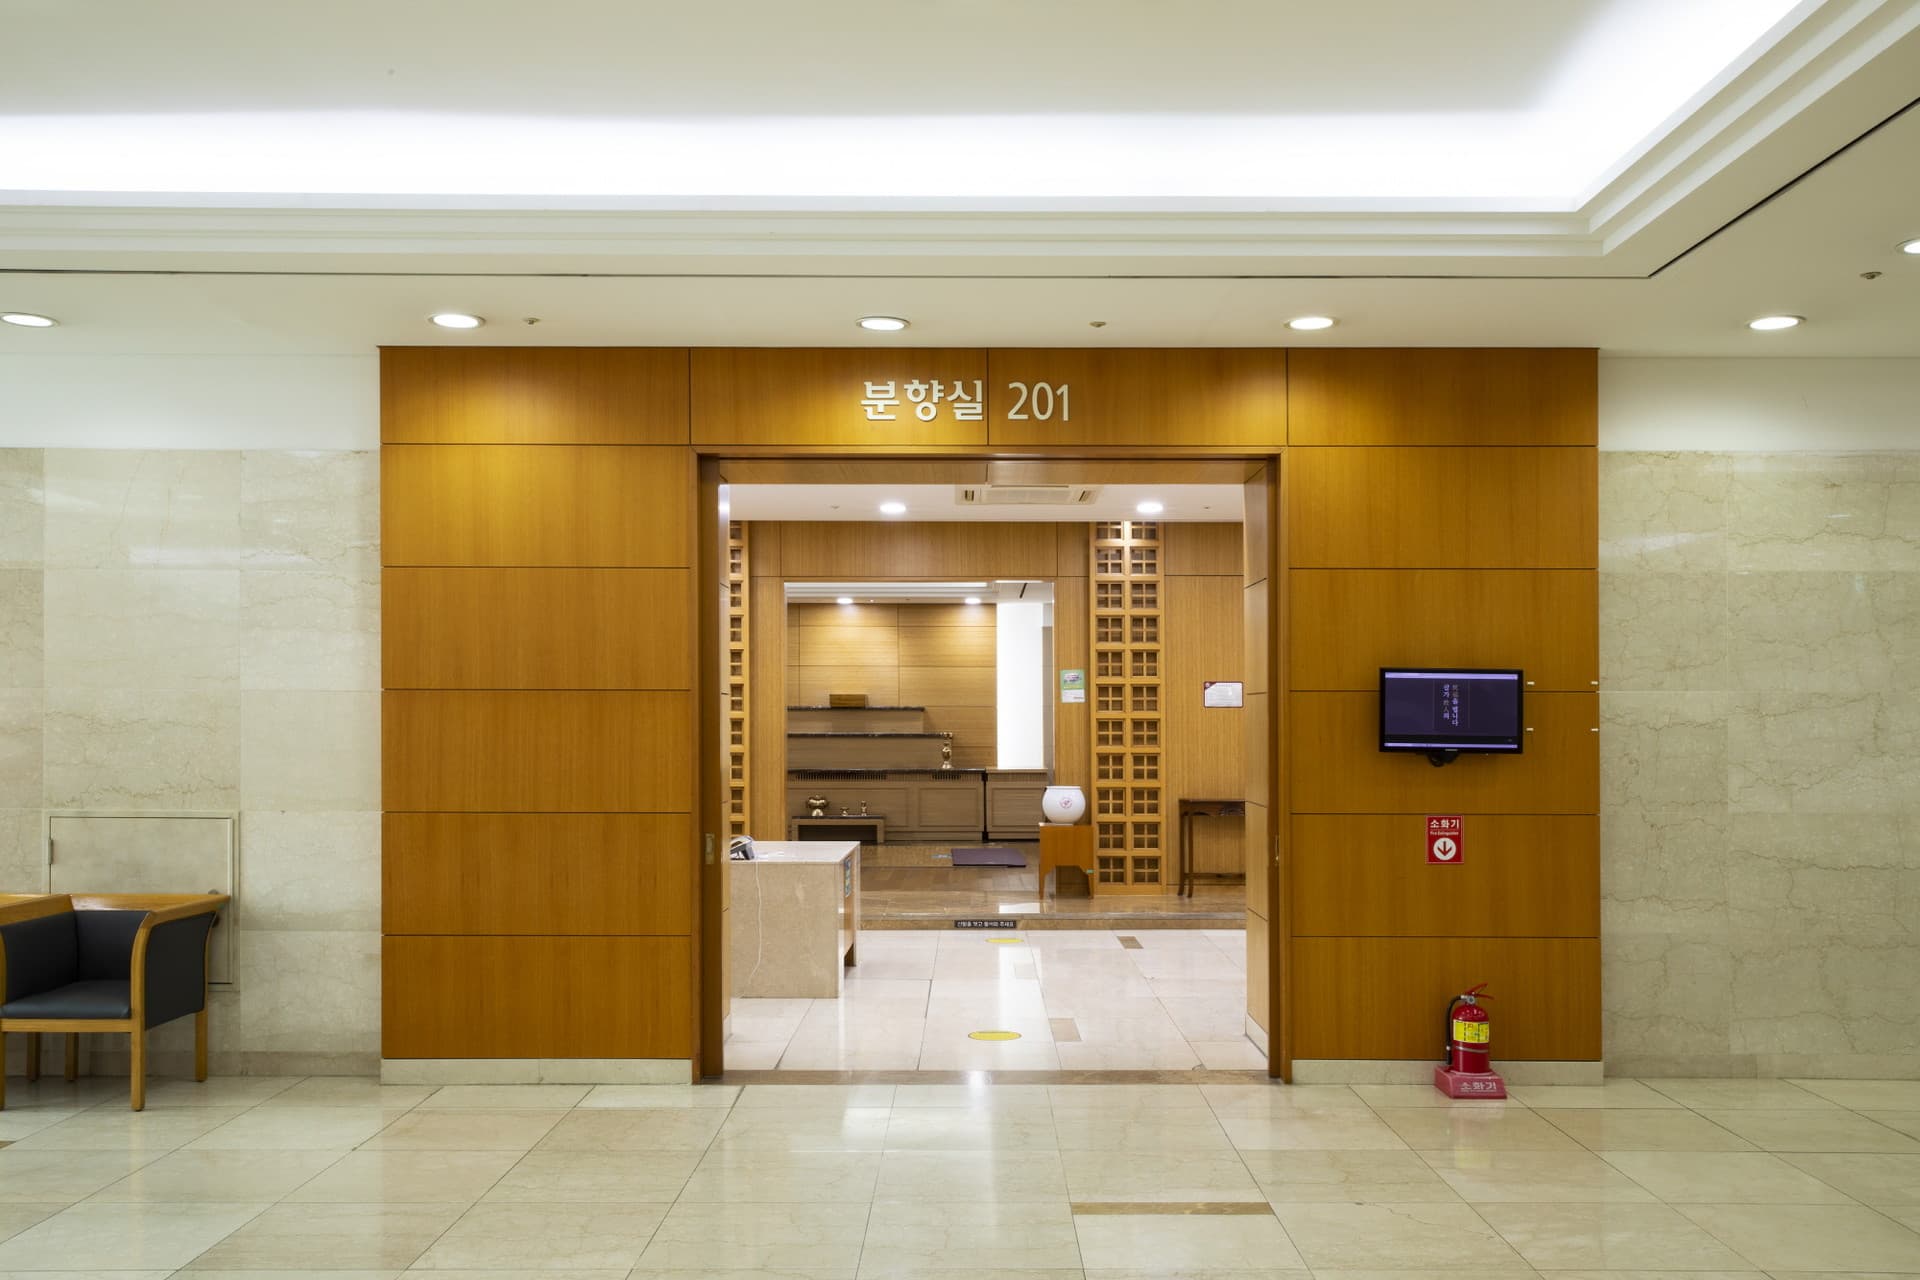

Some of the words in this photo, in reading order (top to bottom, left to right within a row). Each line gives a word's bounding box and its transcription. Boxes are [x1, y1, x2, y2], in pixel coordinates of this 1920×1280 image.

[860, 379, 984, 421] 분향실
[1007, 382, 1070, 421] 201
[1429, 819, 1460, 829] 소화기
[1460, 1081, 1497, 1090] 소화기
